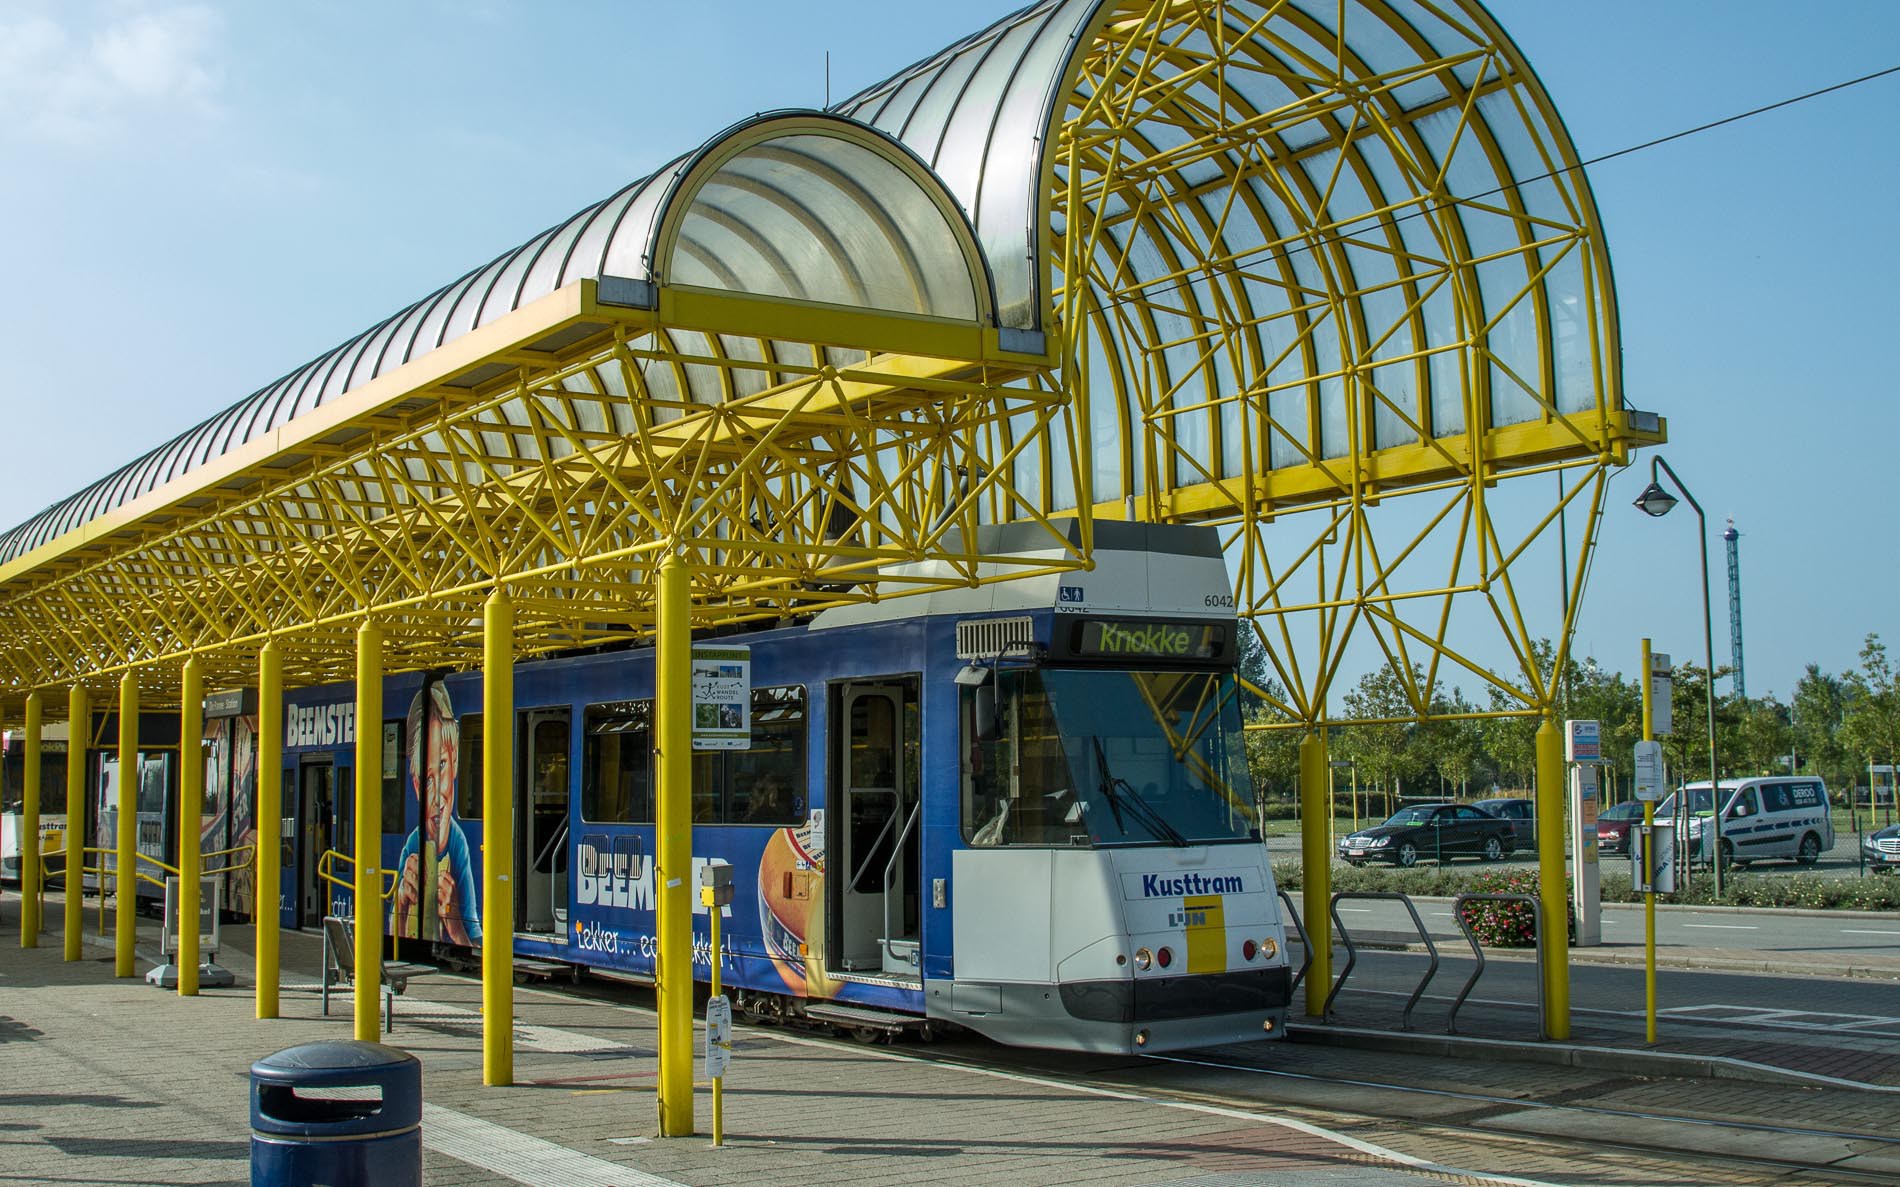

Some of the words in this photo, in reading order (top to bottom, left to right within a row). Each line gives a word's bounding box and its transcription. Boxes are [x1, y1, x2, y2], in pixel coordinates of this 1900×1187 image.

[1204, 595, 1233, 608] 6042
[1100, 622, 1190, 654] Knokke
[1143, 873, 1243, 898] Kusttram
